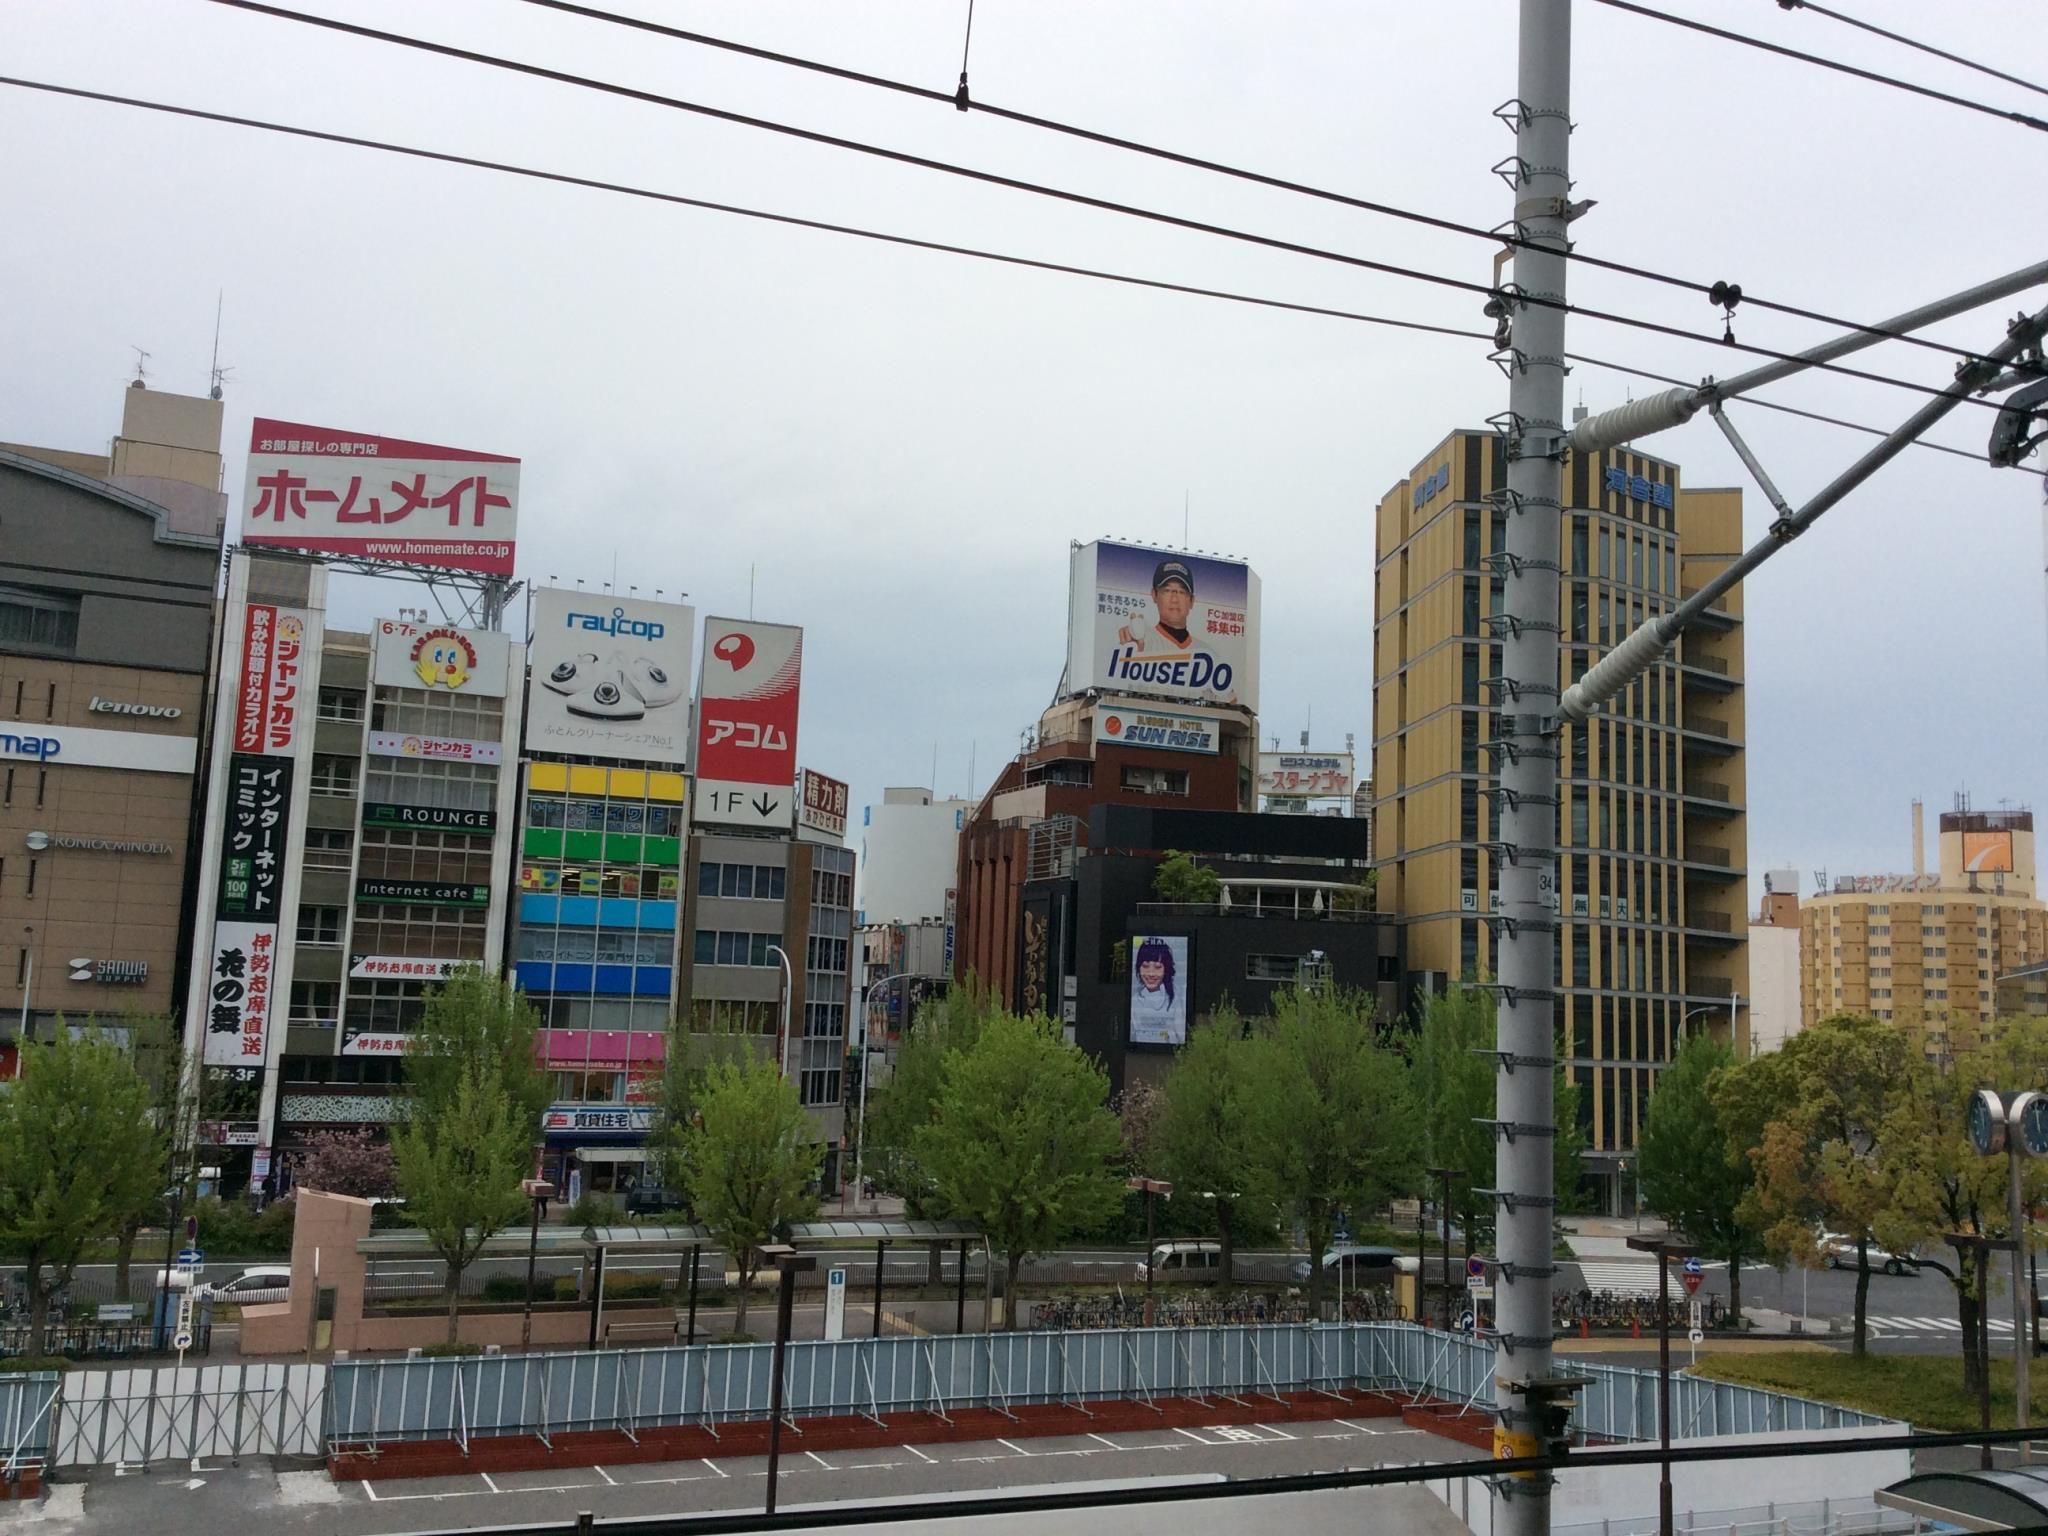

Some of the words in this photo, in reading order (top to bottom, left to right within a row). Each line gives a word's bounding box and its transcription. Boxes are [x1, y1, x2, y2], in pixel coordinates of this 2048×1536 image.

[260, 439, 378, 455] お部屋探しの専門店
[252, 469, 512, 527] ホームメイト
[366, 541, 509, 558] www.homemate.co.jp
[1097, 593, 1146, 608] 家を売るなら
[1097, 604, 1129, 617] 買うなら
[567, 607, 665, 641] raycop
[241, 609, 271, 748] 飲み放題付カラオケ
[270, 640, 300, 748] ジャンカラ
[89, 696, 182, 719] lenovo
[707, 720, 788, 750] アコム
[423, 740, 472, 753] ジャンカラ
[709, 791, 744, 813] 1F
[807, 773, 846, 816] 精力剤
[232, 768, 260, 850] コミック
[403, 808, 489, 826] ROUNGE
[255, 768, 283, 911] インターネット
[227, 880, 248, 892] 100
[435, 888, 468, 899] cafe
[97, 959, 148, 976] SANWA
[209, 947, 248, 1035] 花の舞
[241, 932, 273, 1056] 伊勢志摩直送
[574, 1113, 628, 1128] 賃貸住宅
